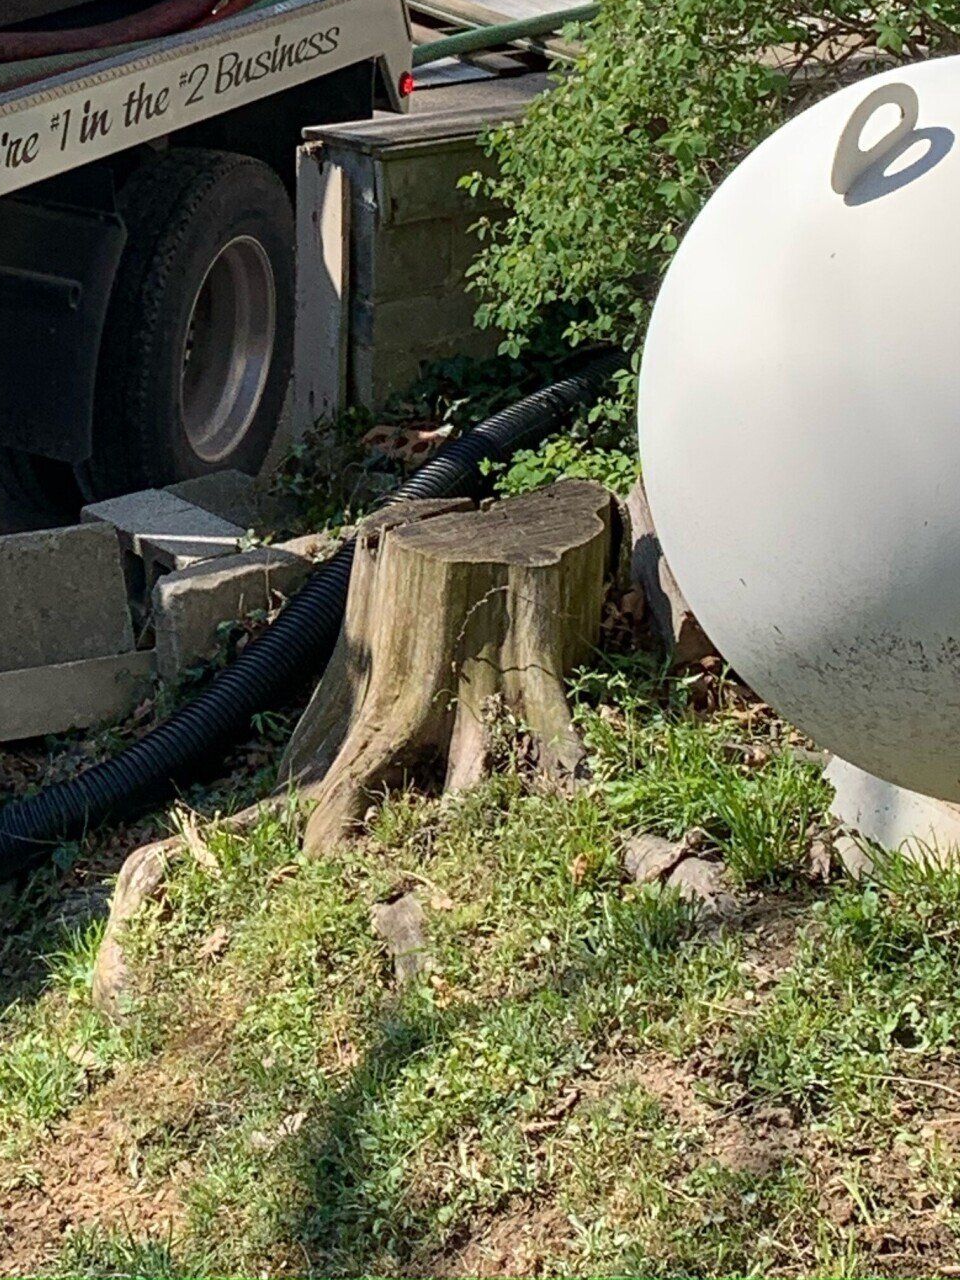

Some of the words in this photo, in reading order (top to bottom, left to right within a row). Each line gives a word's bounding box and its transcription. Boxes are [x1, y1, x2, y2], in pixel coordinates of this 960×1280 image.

[79, 100, 112, 143] in
[122, 81, 170, 128] the
[179, 63, 210, 107] #2
[214, 26, 341, 94] Business
